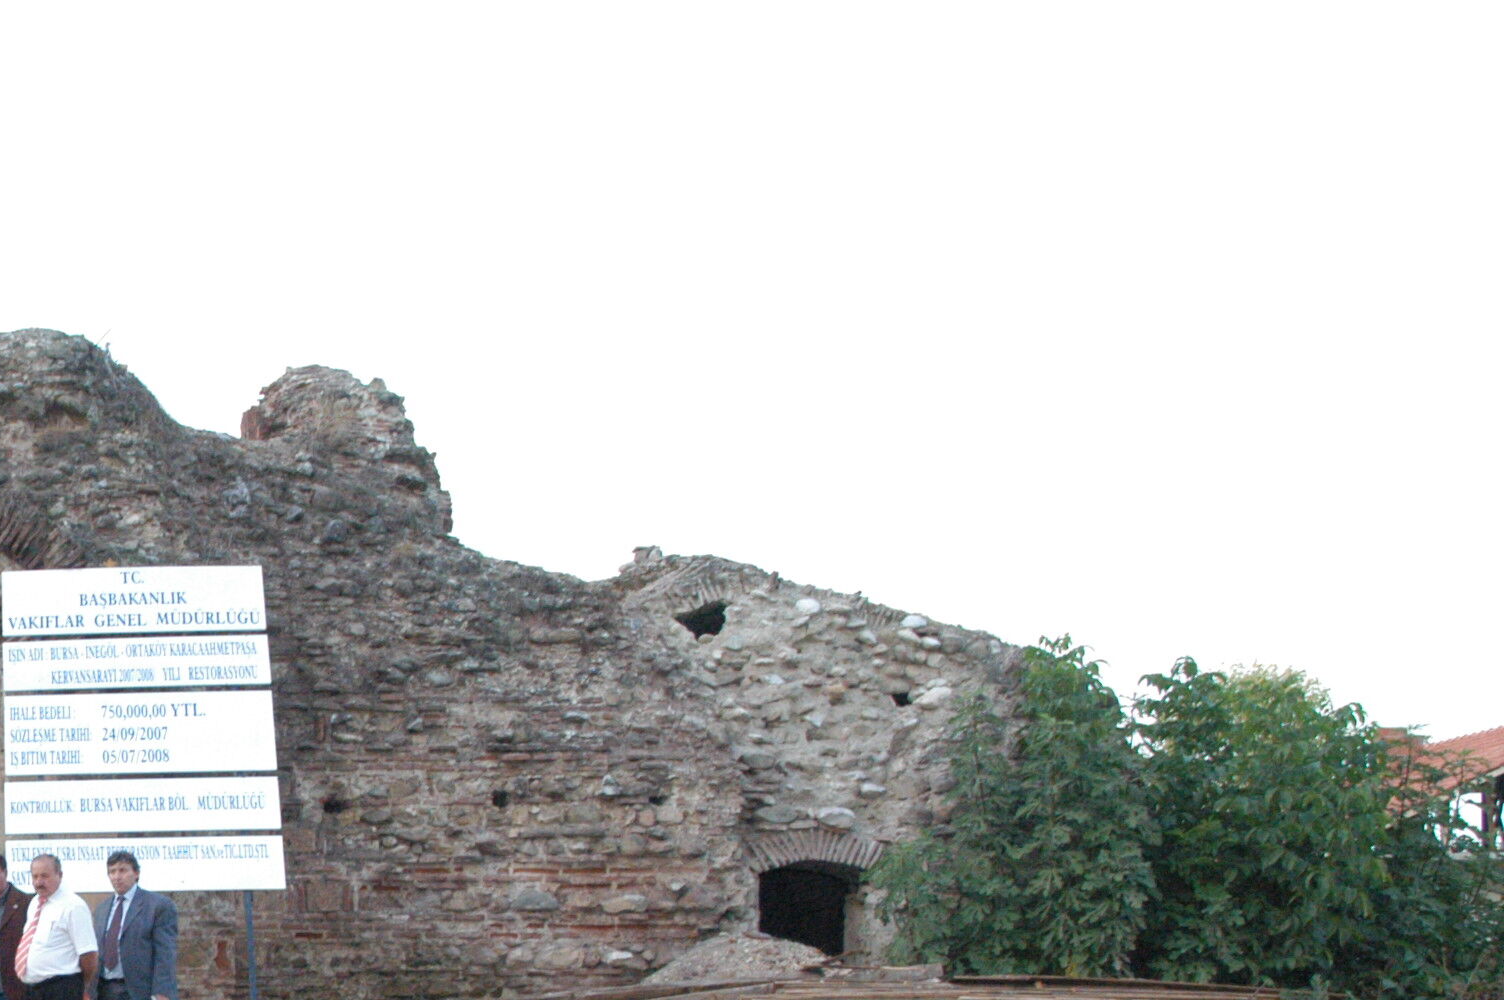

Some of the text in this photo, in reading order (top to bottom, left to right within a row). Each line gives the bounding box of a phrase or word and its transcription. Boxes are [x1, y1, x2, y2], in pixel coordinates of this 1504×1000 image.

[79, 591, 187, 609] BAŞBAKANLIK
[8, 607, 260, 630] VAKIFLAR GENEL MÜDÜRLÜĞÜ
[50, 646, 79, 661] BURSA
[188, 664, 258, 681] RESTORASYONU
[101, 703, 166, 720] 750,000,00
[102, 726, 168, 741] 24/09/2007
[102, 748, 170, 764] 05/07/2008
[79, 797, 113, 813] BURSA
[115, 796, 166, 812] VAKIFLAR
